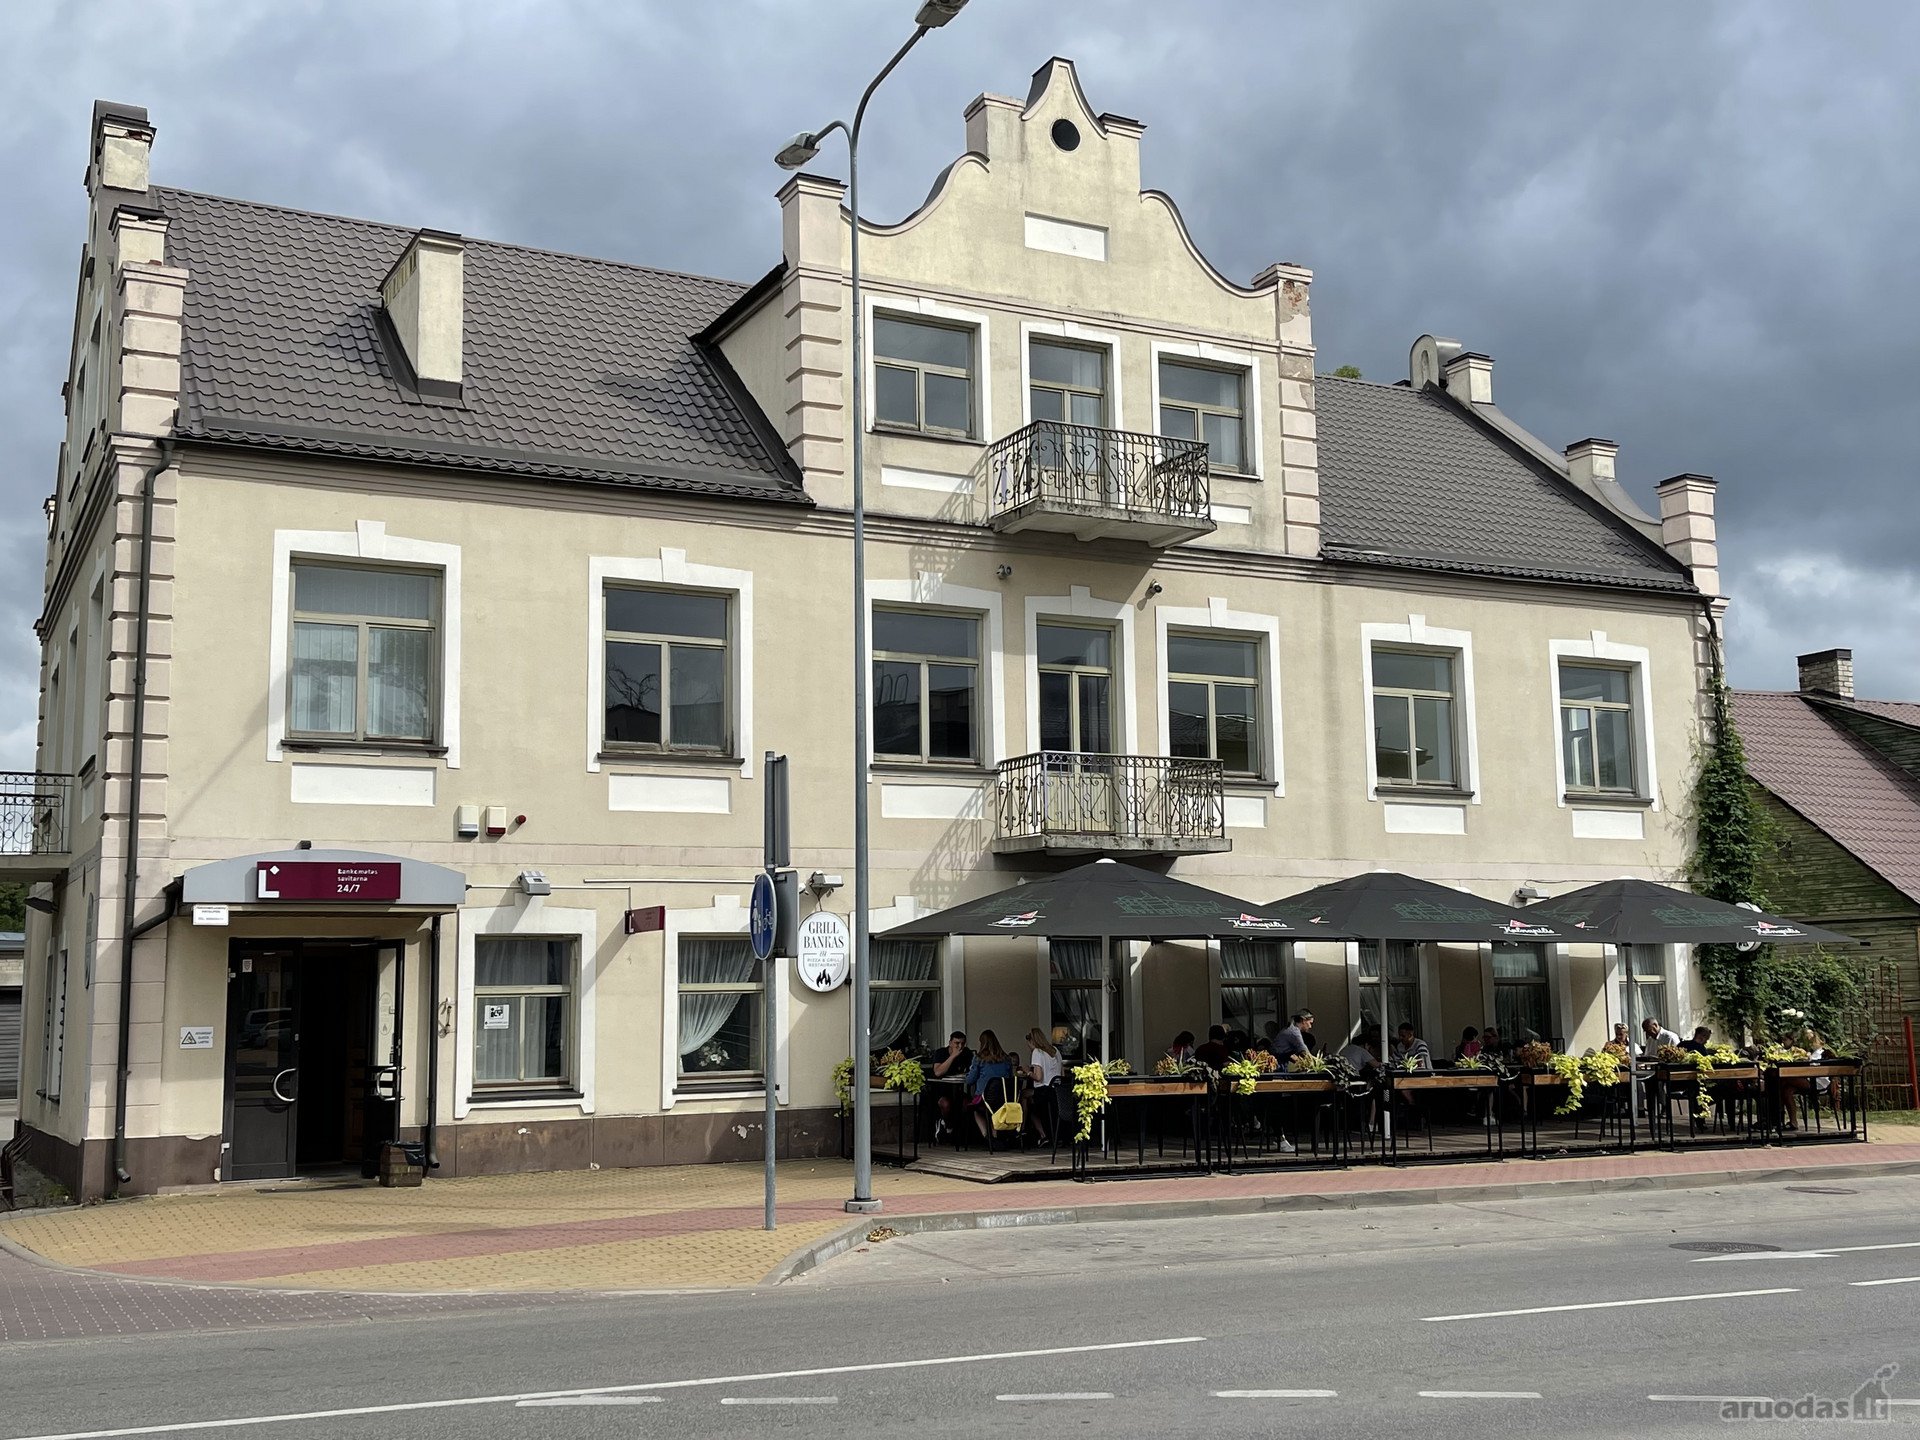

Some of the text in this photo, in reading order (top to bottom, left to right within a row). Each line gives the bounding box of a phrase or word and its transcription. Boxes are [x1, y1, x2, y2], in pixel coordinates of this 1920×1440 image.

[337, 884, 361, 893] 24/7
[808, 921, 840, 934] GRILL
[803, 936, 845, 949] BANKAS
